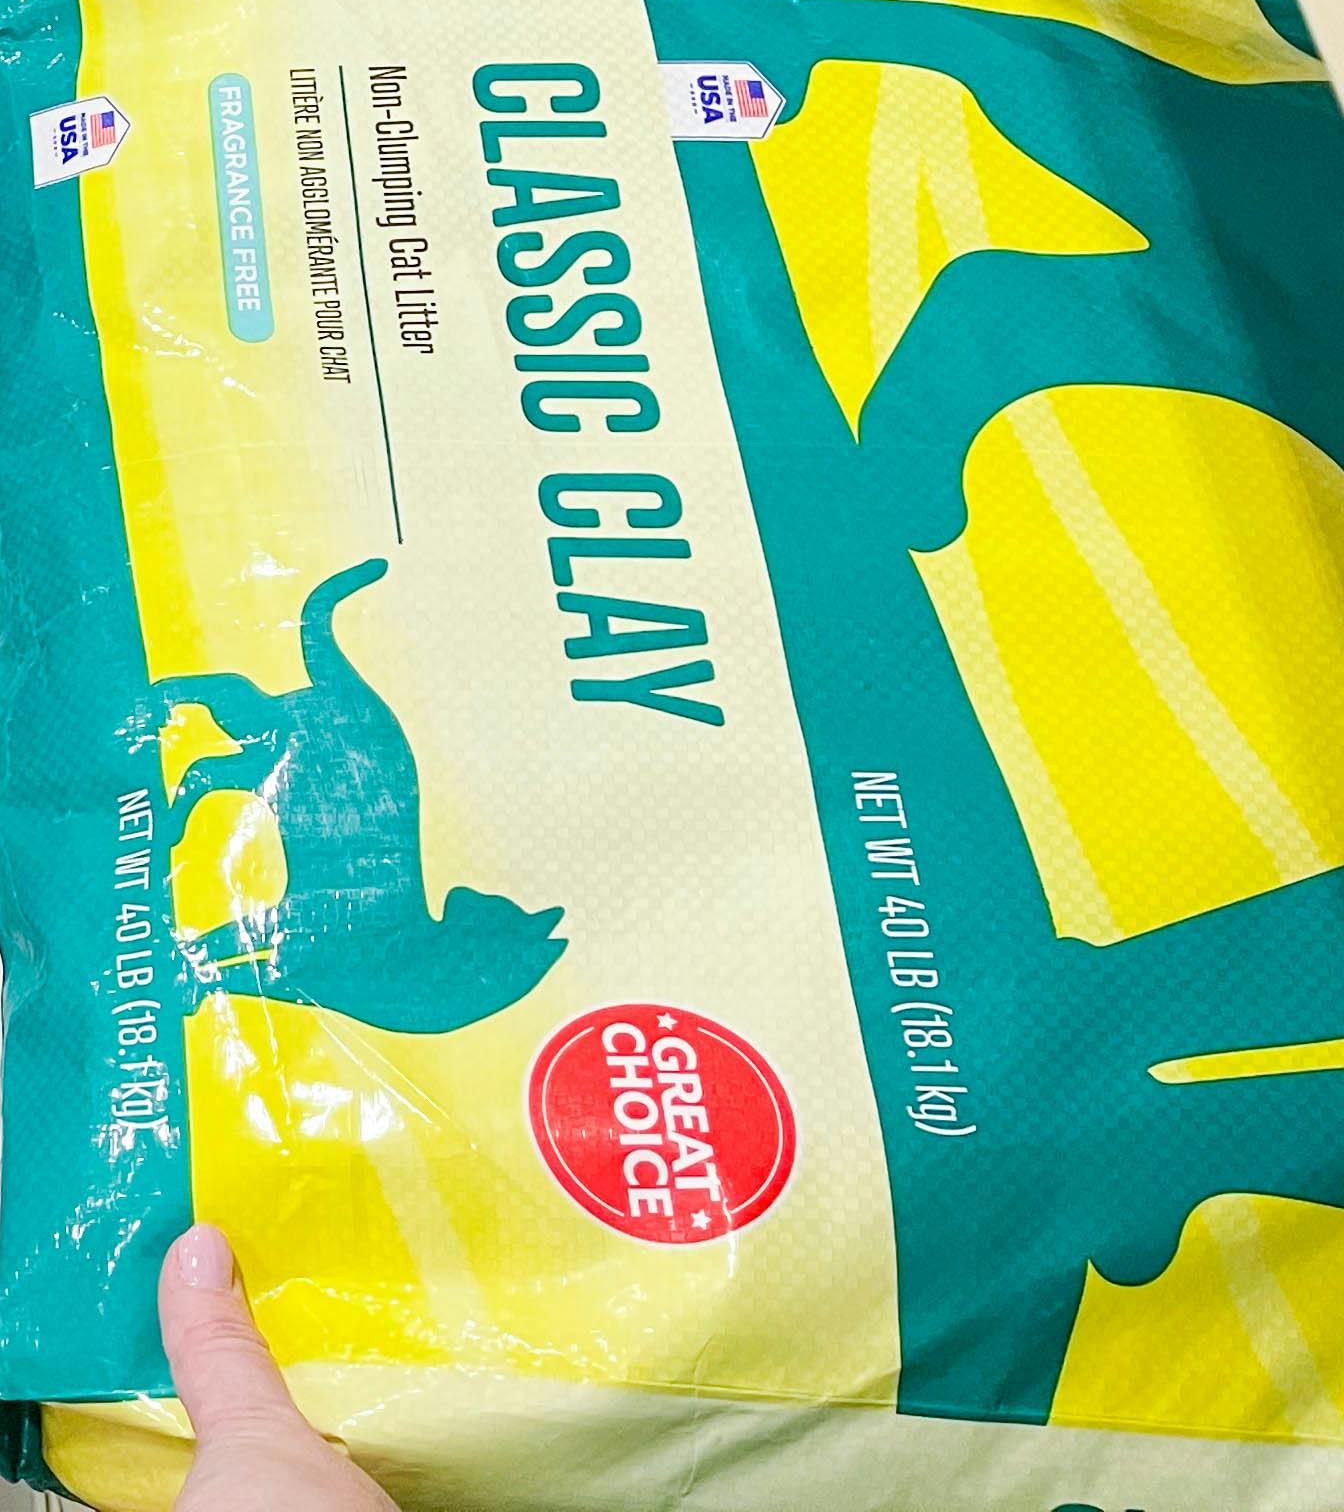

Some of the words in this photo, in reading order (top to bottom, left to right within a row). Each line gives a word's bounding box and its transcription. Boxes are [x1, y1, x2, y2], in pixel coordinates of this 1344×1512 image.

[289, 68, 322, 125] LITIÈRE
[696, 75, 724, 125] USA
[59, 115, 79, 165] USA
[218, 85, 255, 243] FRAGRANCE
[296, 129, 325, 161] NON
[367, 65, 424, 229] Non-Clumping
[299, 166, 340, 298] AGGLOMÉRANTE
[471, 61, 662, 433] CLASSIC
[232, 247, 262, 313] FREE
[388, 237, 433, 282] Cat
[313, 299, 345, 343] POUR
[394, 289, 440, 355] Litter
[319, 346, 352, 384] CHAT
[537, 472, 725, 728] CLAY
[116, 788, 154, 842] NET
[850, 770, 909, 830] NET
[113, 848, 152, 890] WT
[863, 837, 921, 887] WT
[115, 903, 152, 944] 40
[878, 894, 930, 939] 40
[115, 950, 154, 989] LB
[886, 950, 940, 989] LB
[891, 1001, 960, 1073] (18.1
[600, 1021, 675, 1218] CHOICE
[651, 1035, 722, 1203] GREAT
[906, 1085, 977, 1137] kg)
